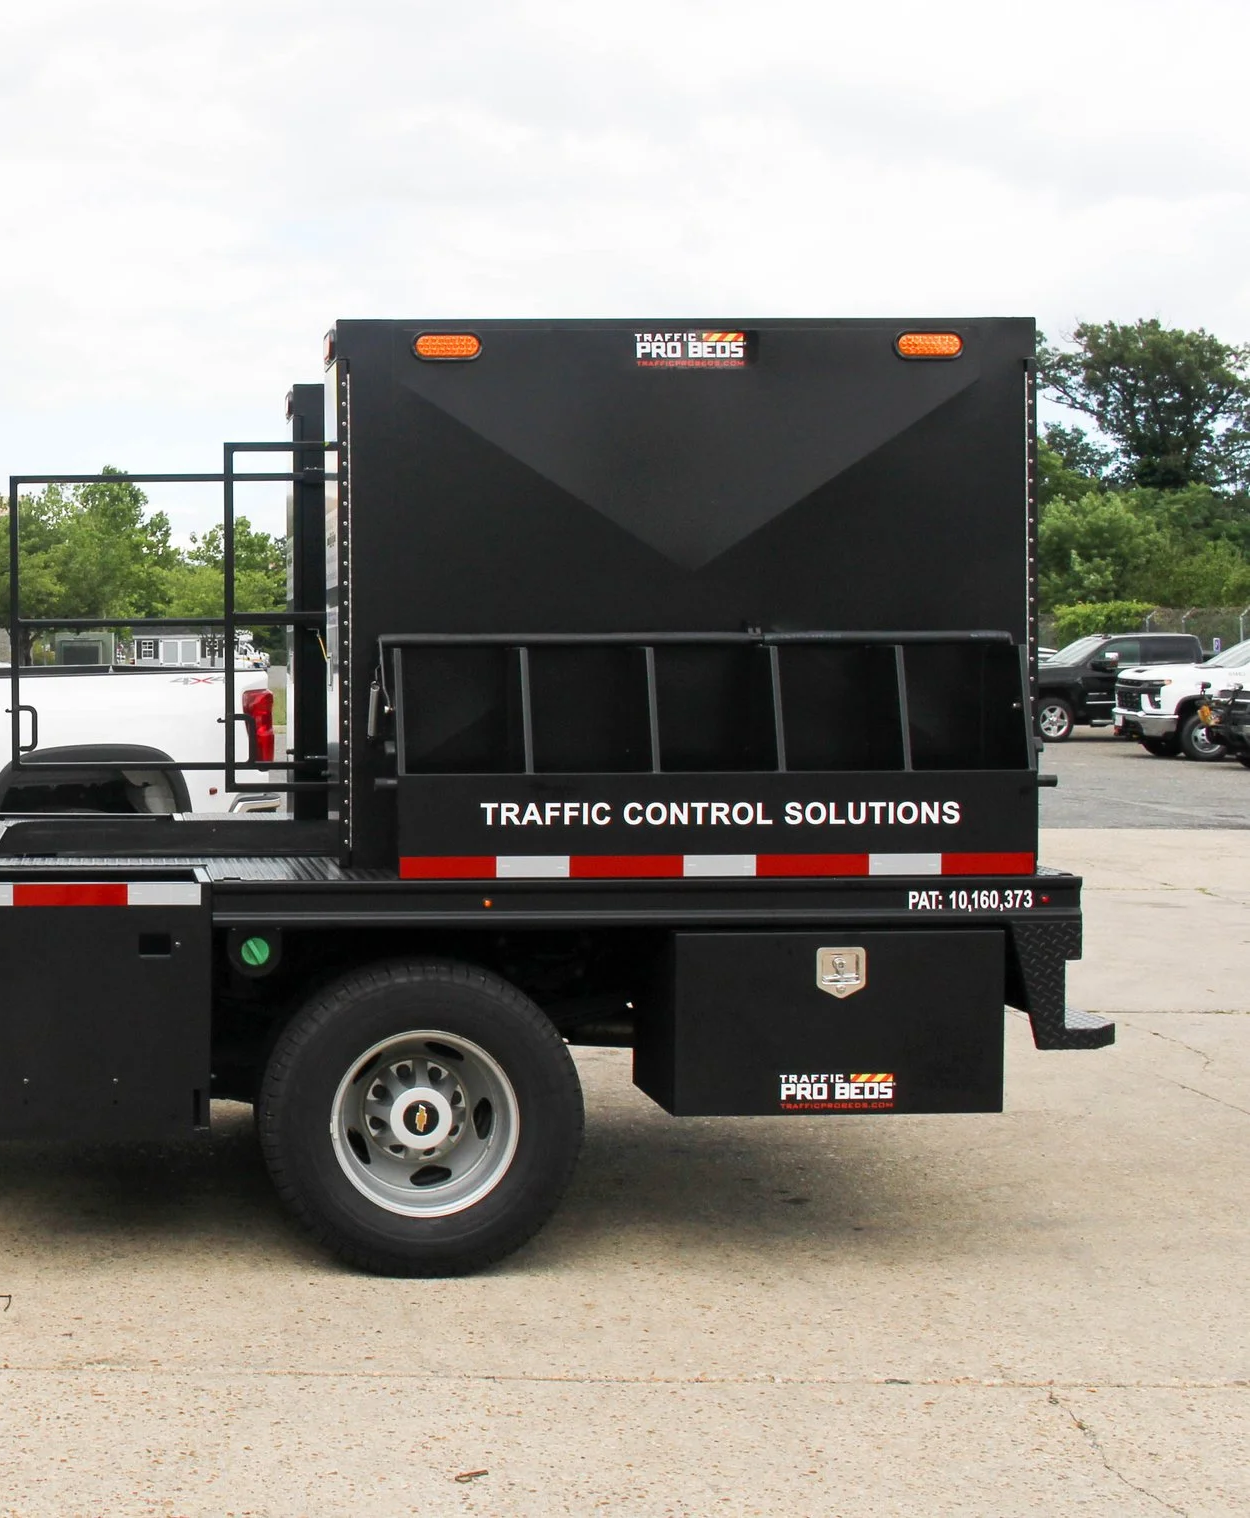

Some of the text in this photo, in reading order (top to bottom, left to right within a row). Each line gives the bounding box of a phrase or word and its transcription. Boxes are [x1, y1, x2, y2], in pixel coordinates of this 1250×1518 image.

[634, 333, 697, 342] TRAFFIC
[636, 341, 745, 358] PRO BEDS
[480, 800, 962, 826] TRAFFIC CONTROL SOLUTIONS
[908, 889, 1034, 912] PAT: 10,160,373
[779, 1073, 844, 1083] TRAFFIC
[780, 1082, 893, 1100] PRO BEDS
[780, 1101, 894, 1110] TRAFFICPROBEDS.COM
